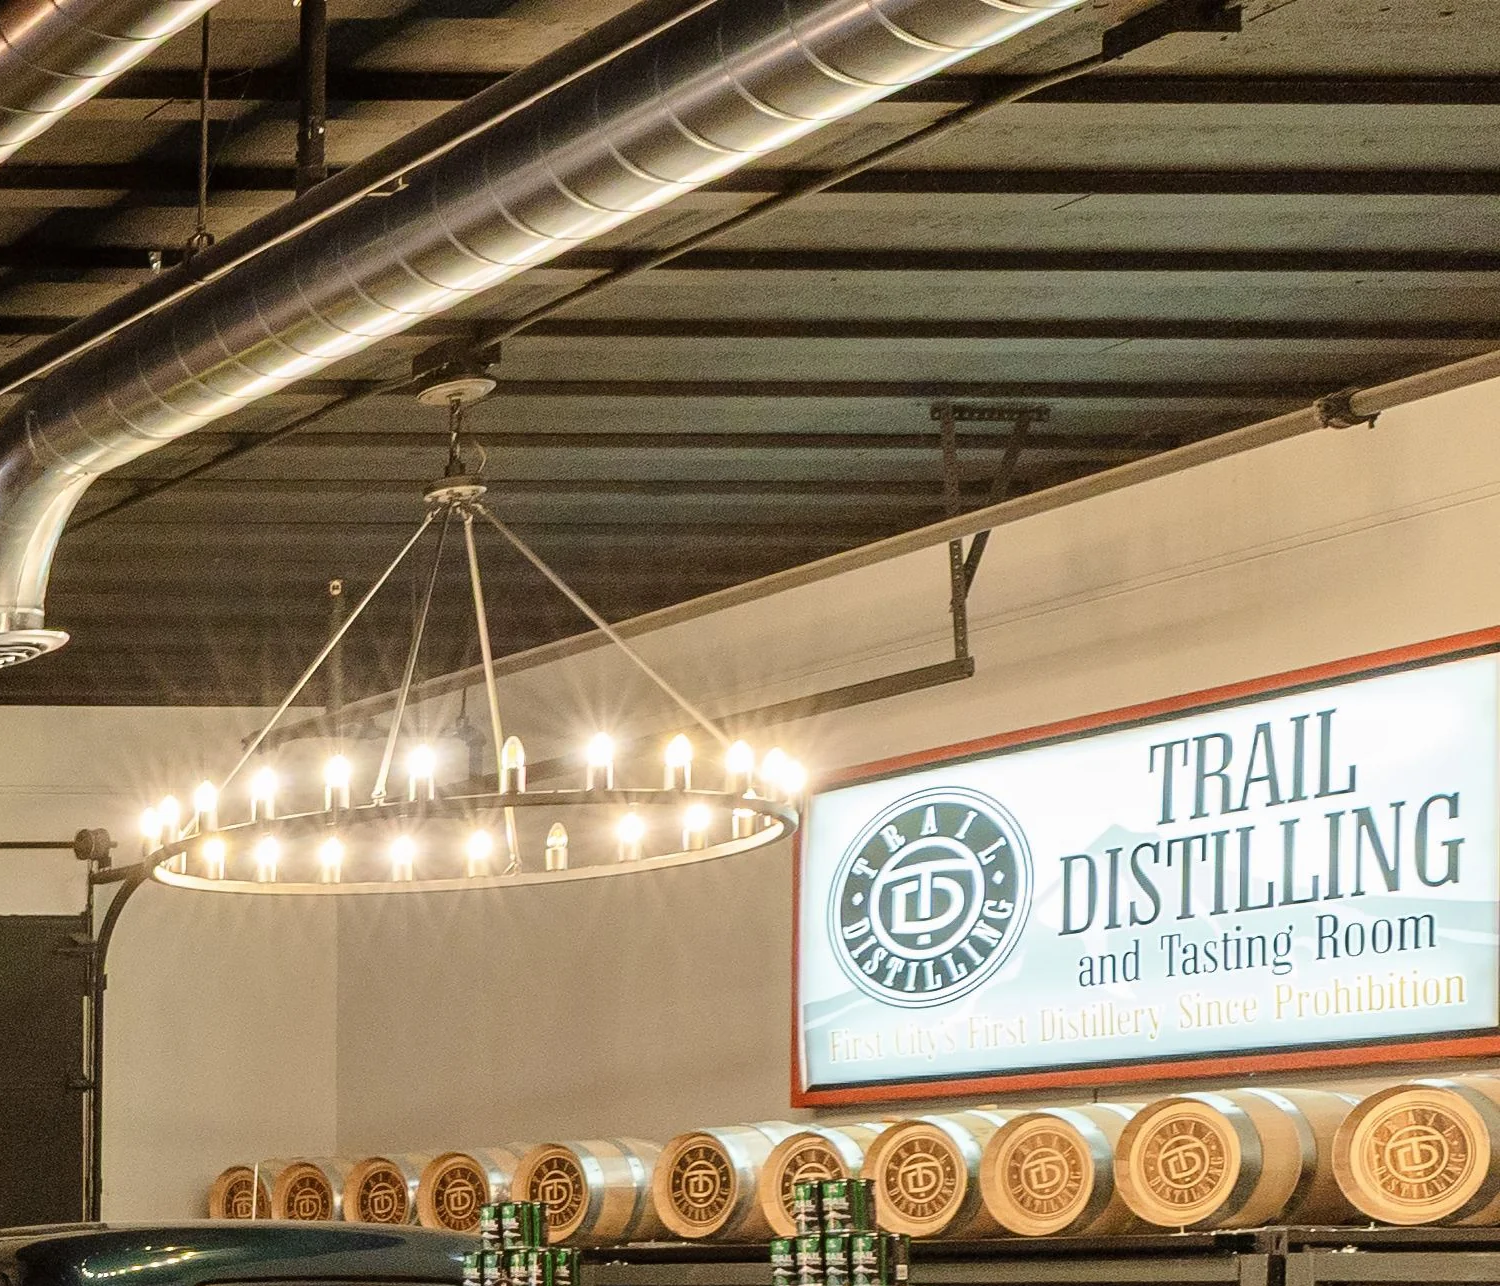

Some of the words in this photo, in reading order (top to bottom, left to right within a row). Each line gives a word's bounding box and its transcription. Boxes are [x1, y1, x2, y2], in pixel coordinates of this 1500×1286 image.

[1148, 708, 1357, 824] TRAIL
[852, 806, 1007, 879] TRAIL
[1058, 791, 1465, 936] DISTILLING
[843, 899, 1013, 991] DISTILLING
[1079, 942, 1139, 987] and
[1161, 925, 1293, 978] Tasting
[1316, 911, 1437, 960] Room
[830, 1030, 882, 1062] First
[968, 1015, 1027, 1048] First
[1040, 1000, 1162, 1041] Distillery
[1179, 994, 1257, 1029] Since
[1275, 968, 1465, 1021] Prohibition
